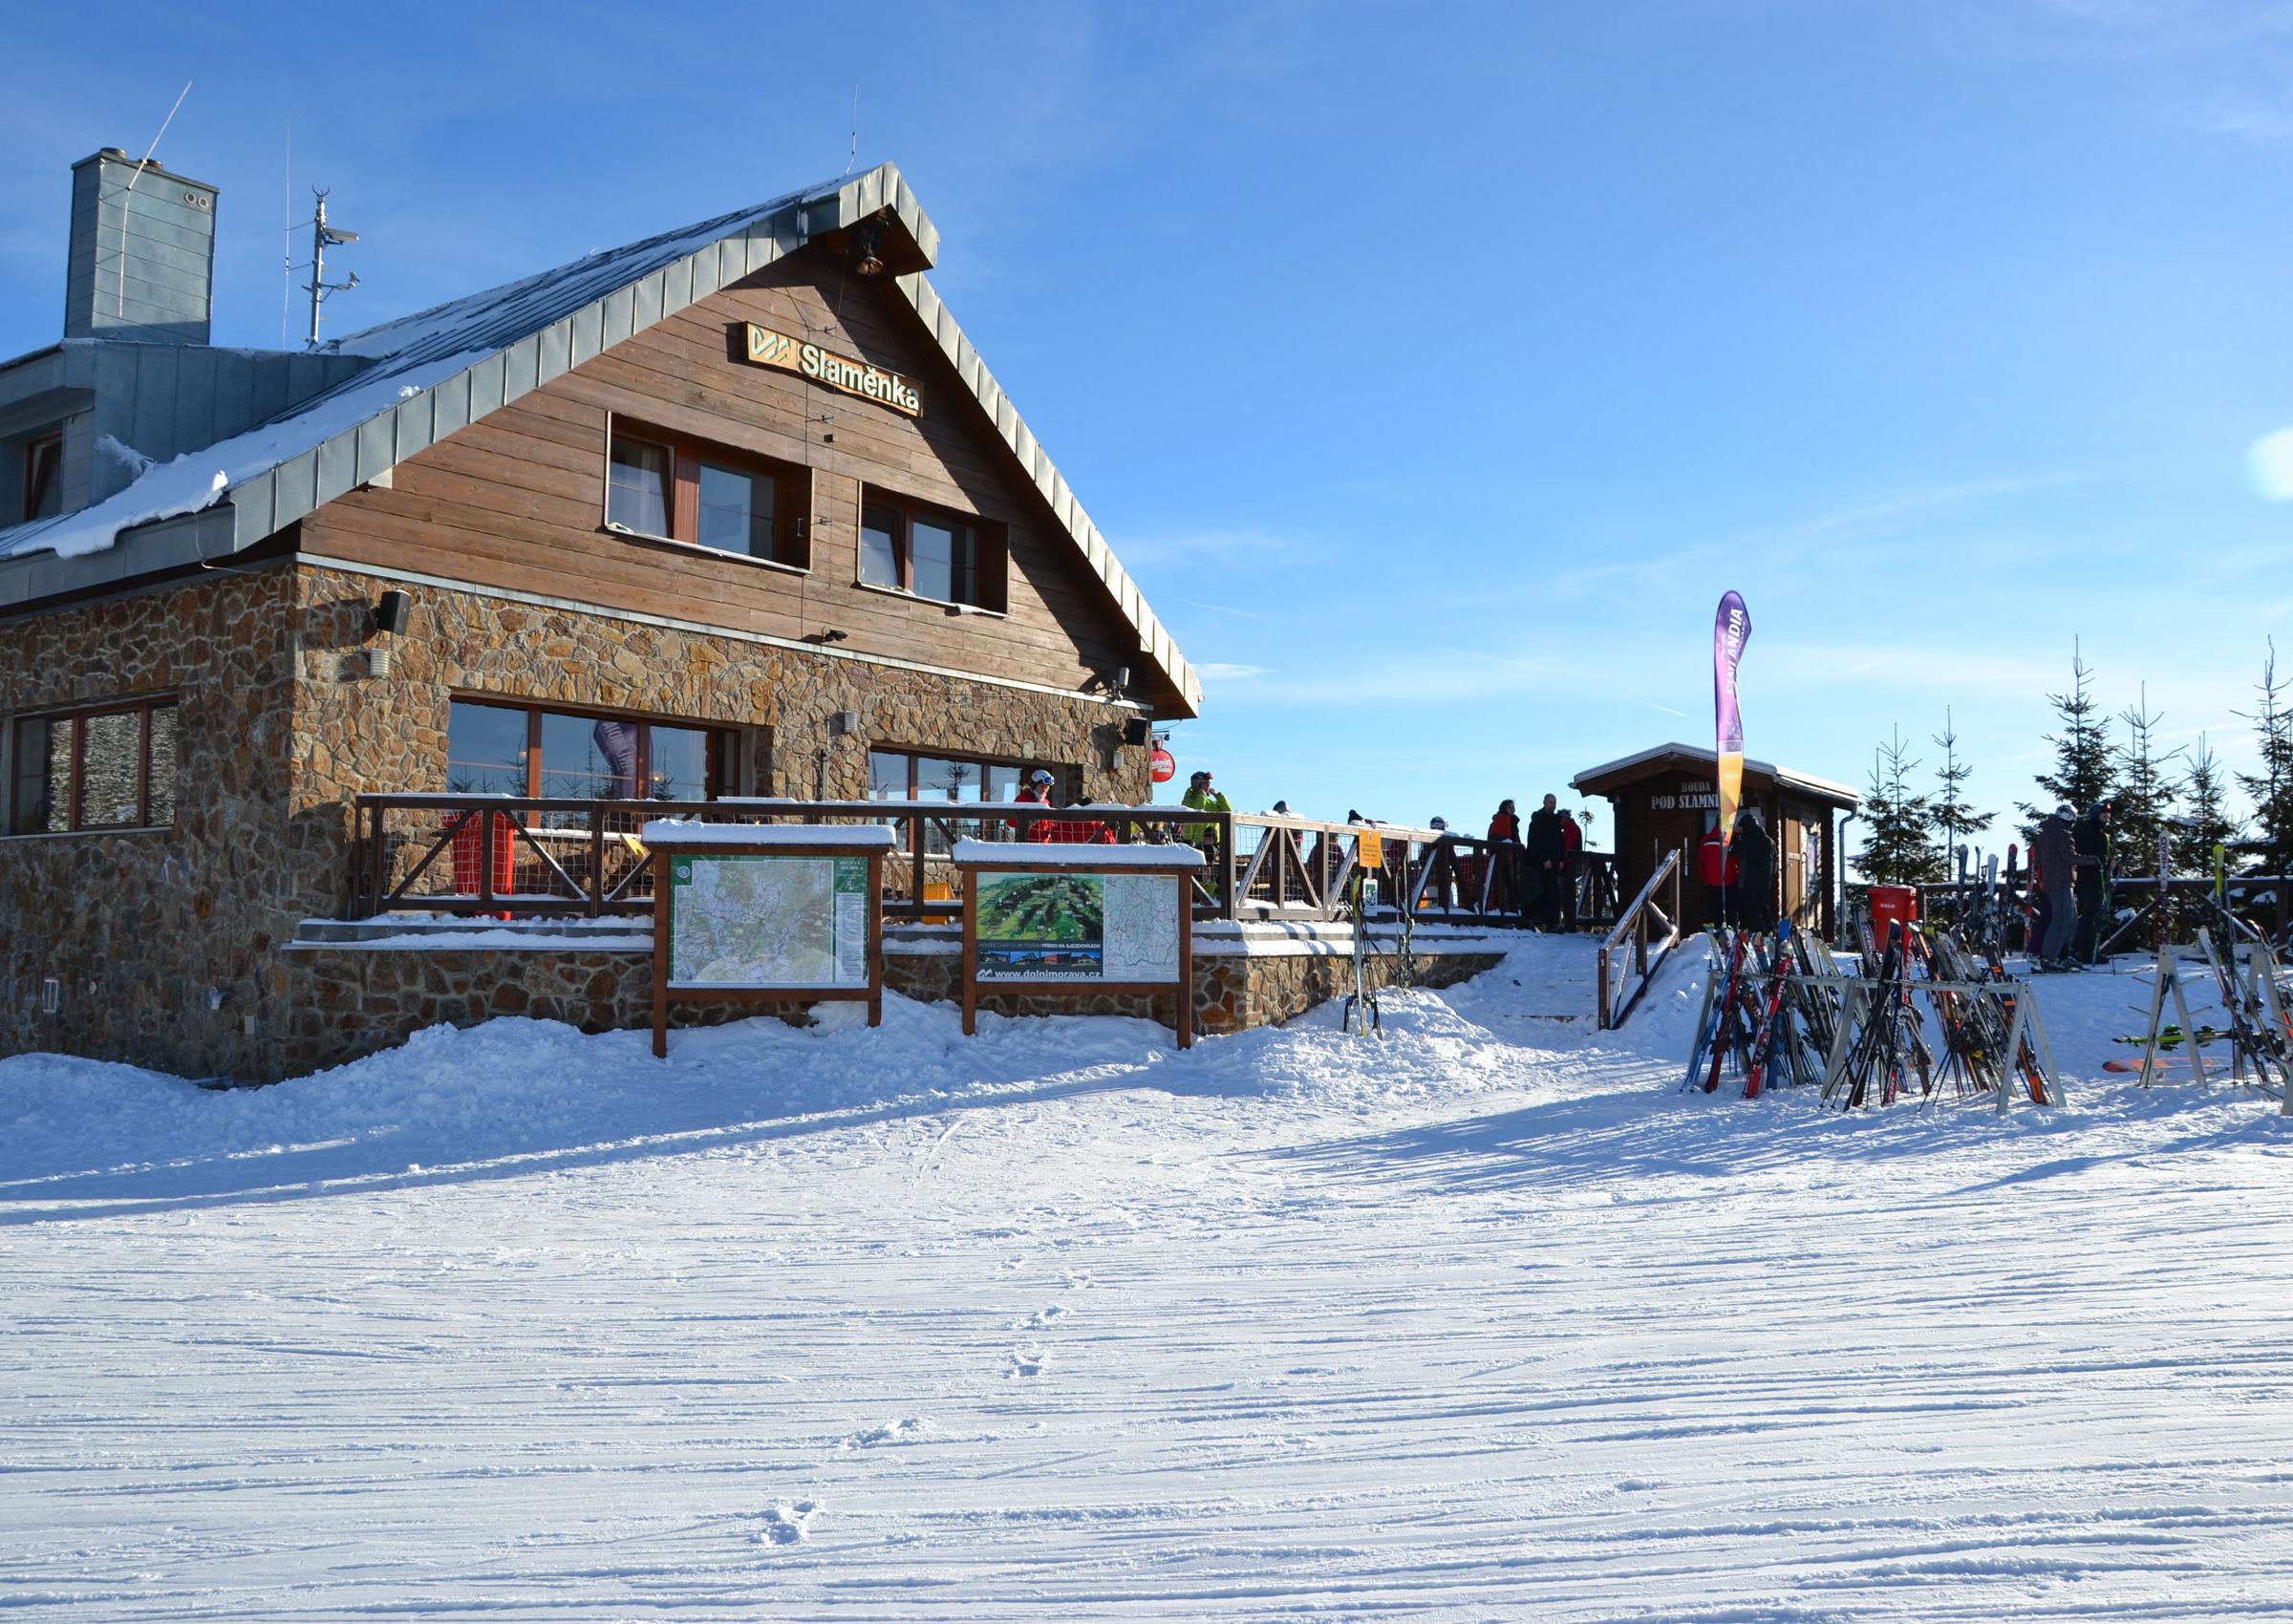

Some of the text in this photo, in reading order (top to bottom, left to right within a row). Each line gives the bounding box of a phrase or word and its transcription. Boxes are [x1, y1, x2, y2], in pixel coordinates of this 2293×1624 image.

[801, 343, 919, 411] Slaměnka
[1681, 781, 1711, 793] BOUDA
[1651, 795, 1676, 810] POD
[995, 969, 1101, 979] www.dolnimorava.cz
